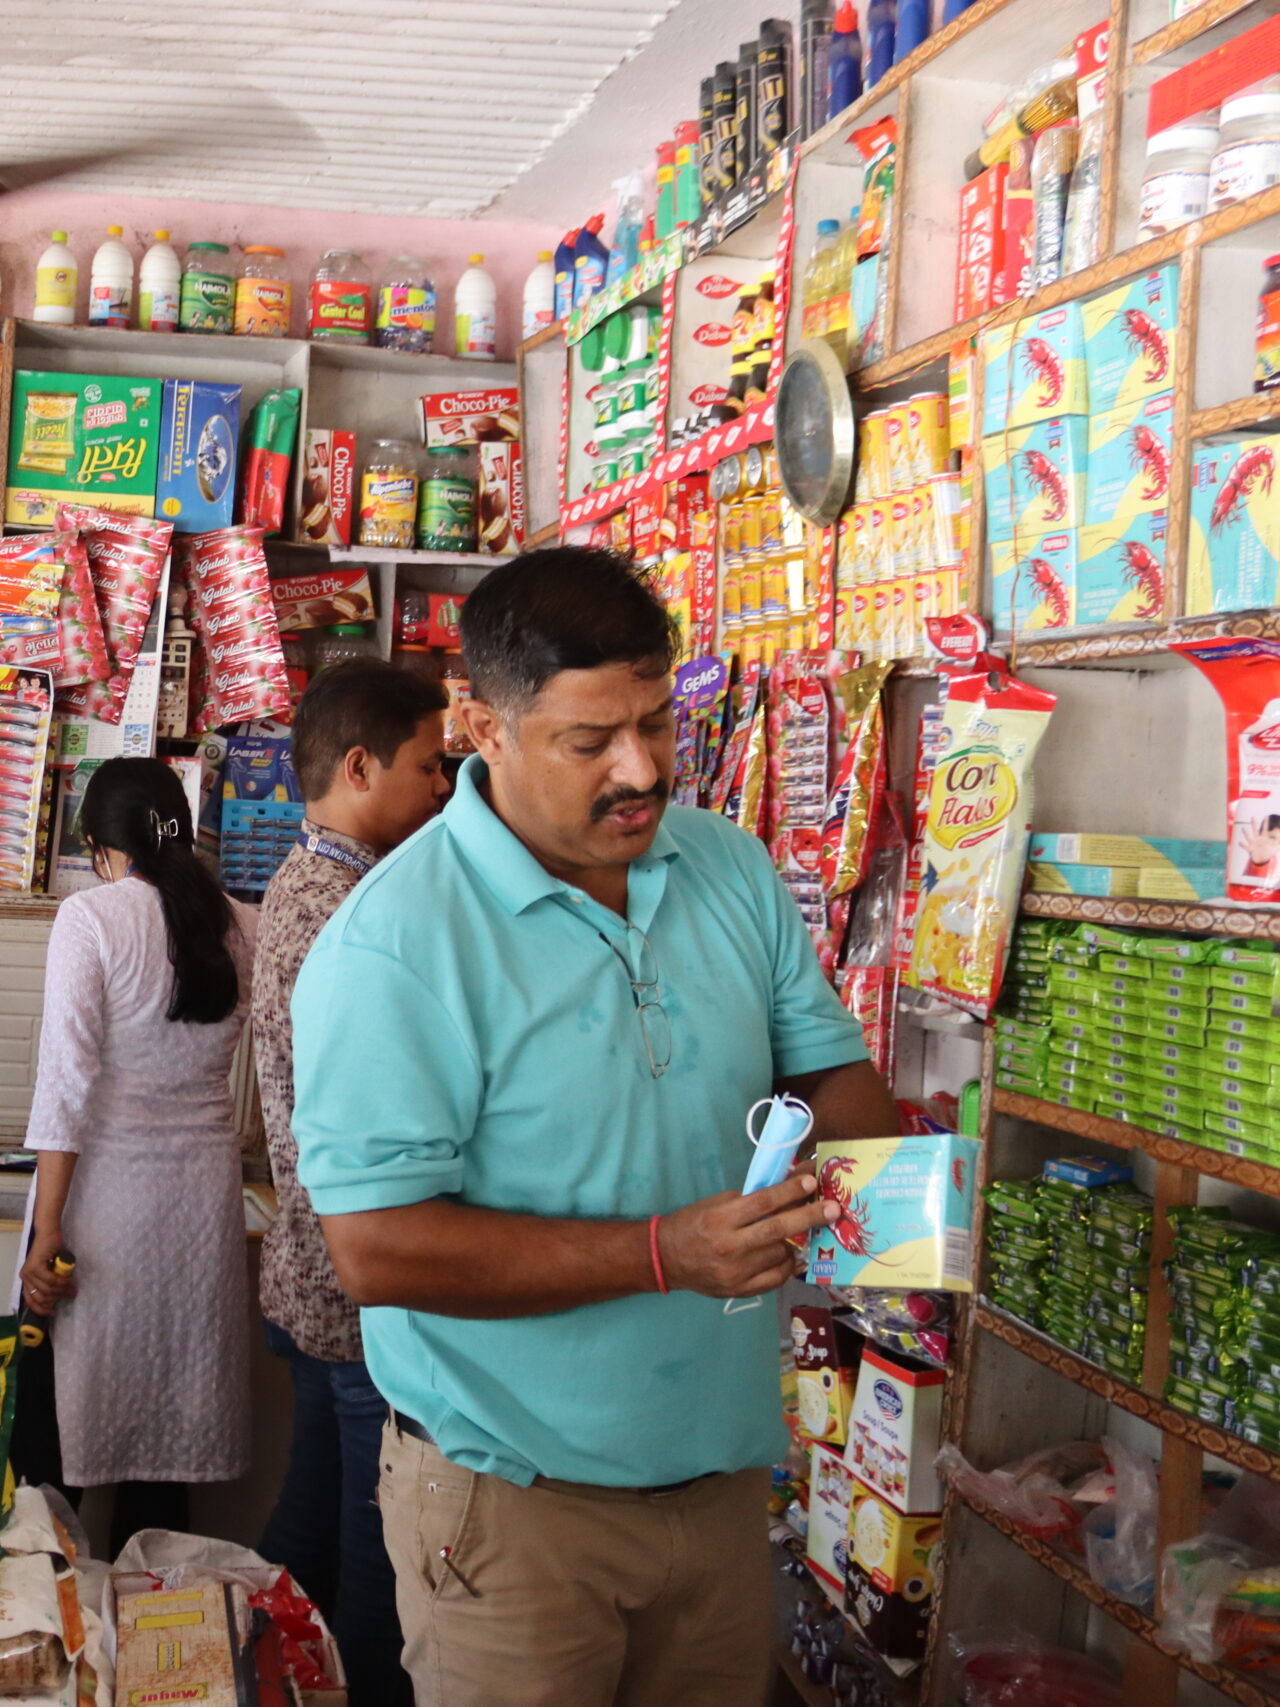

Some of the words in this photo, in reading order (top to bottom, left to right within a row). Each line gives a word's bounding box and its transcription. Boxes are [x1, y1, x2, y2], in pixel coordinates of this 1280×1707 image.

[391, 304, 436, 316] mentos
[89, 541, 128, 562] Gulab
[196, 554, 230, 579] Gulab
[201, 582, 236, 607] Gulab
[206, 609, 241, 635] Gulab
[211, 640, 246, 664] Gulab
[215, 668, 250, 692] Gulab
[682, 664, 720, 694] GEMS
[220, 698, 255, 721] Gulab
